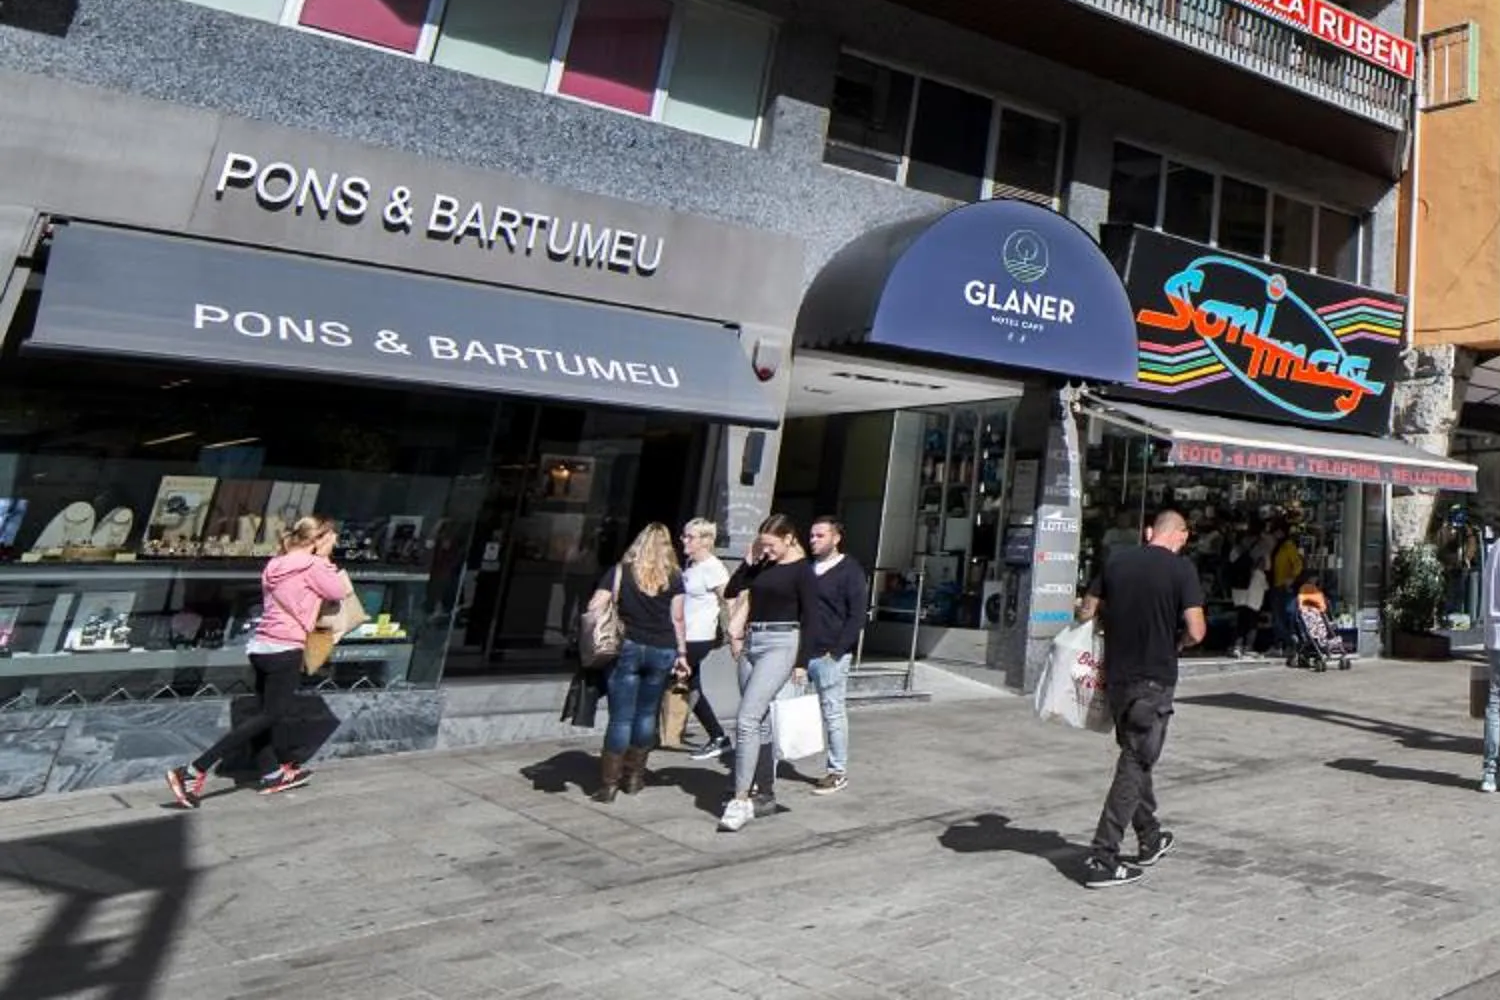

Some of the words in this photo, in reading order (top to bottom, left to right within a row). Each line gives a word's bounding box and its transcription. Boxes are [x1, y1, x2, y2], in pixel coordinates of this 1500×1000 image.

[1317, 7, 1408, 73] RUBEN
[216, 152, 371, 216] PONS
[383, 185, 413, 225] &
[427, 193, 665, 271] BARTUMEU
[964, 280, 1075, 325] GLANER
[194, 303, 353, 348] PONS
[374, 329, 413, 356] &
[428, 335, 681, 389] BARTUMEU
[1179, 442, 1222, 463] FOTO
